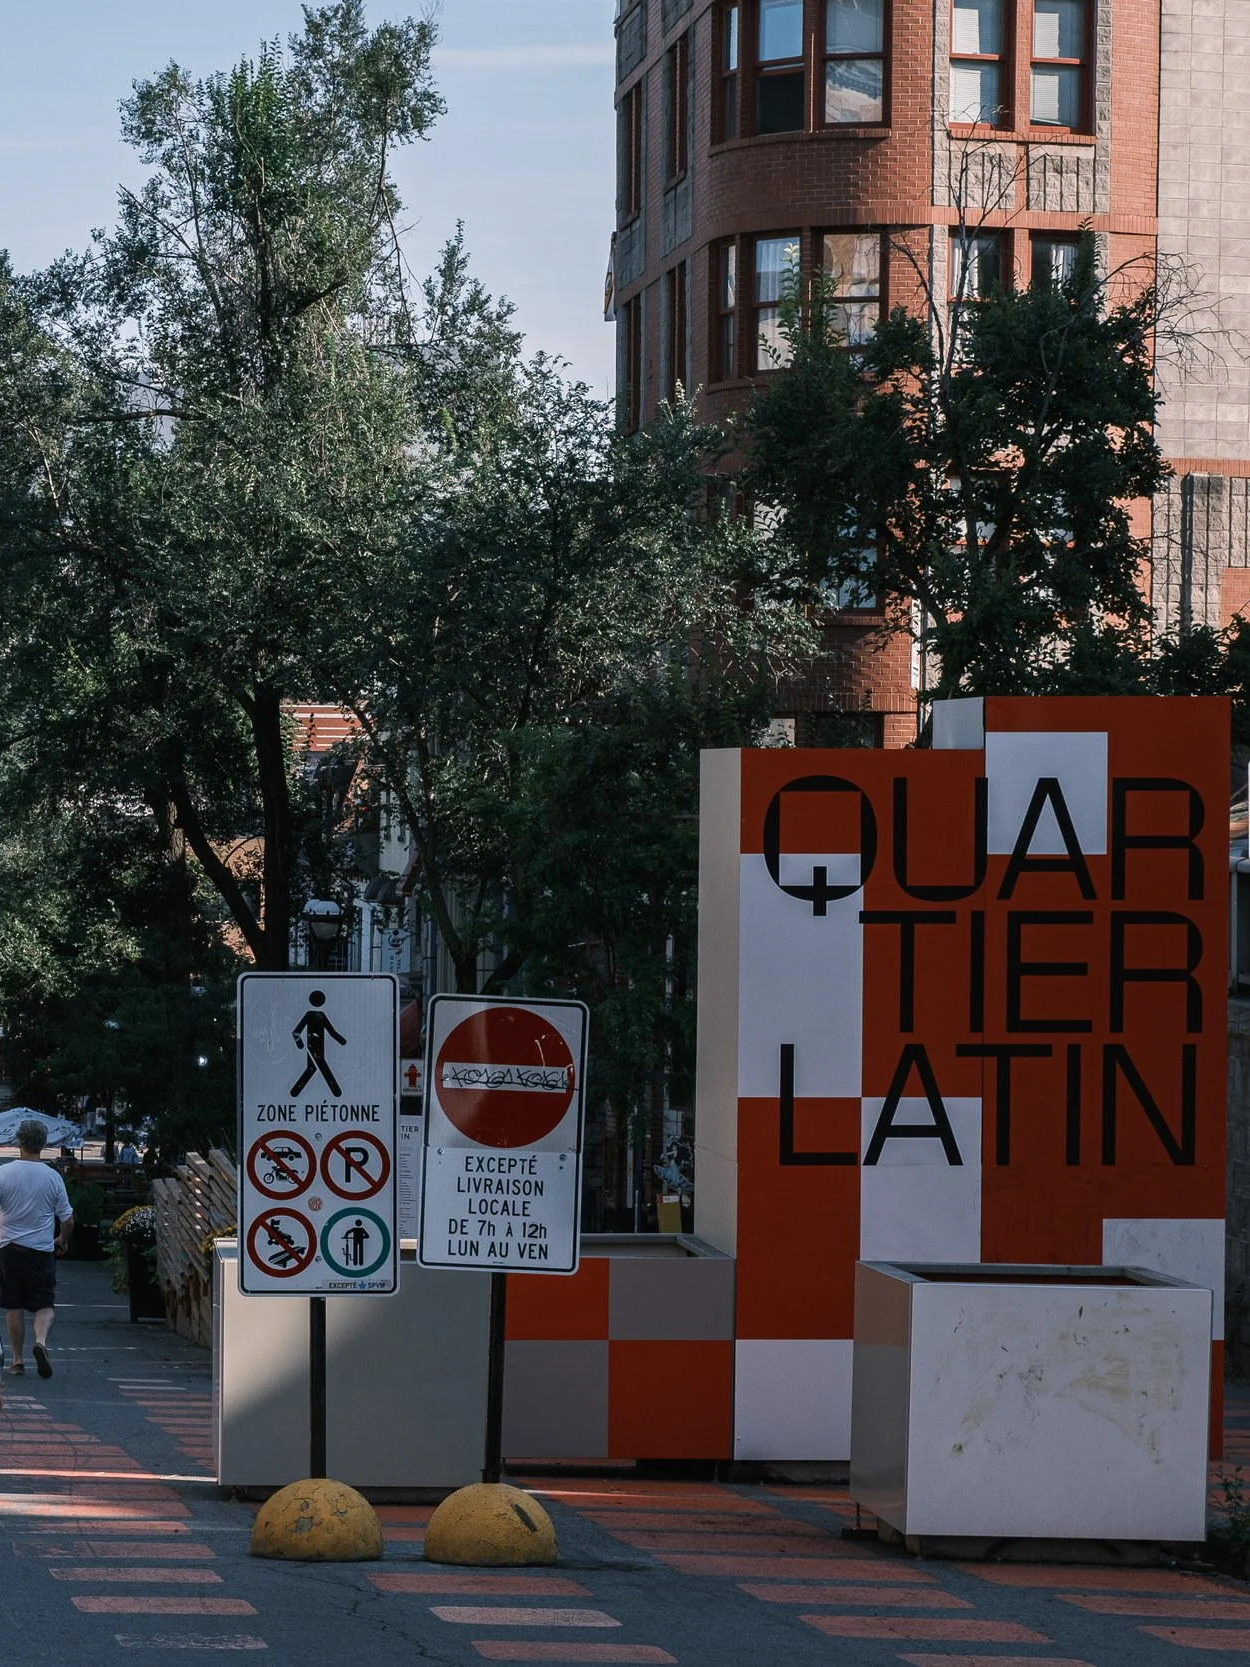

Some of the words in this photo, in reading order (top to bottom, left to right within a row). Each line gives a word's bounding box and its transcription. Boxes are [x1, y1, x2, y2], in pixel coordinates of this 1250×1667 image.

[762, 774, 1205, 917] QUAR
[858, 910, 1203, 1034] TIER
[256, 1105, 297, 1122] ZONE
[305, 1100, 380, 1122] PIÉTONNE
[779, 1043, 1197, 1166] LATIN
[400, 1125, 419, 1133] TIER
[464, 1154, 538, 1175] EXCEPTÉ
[456, 1176, 544, 1197] LIVRAISON
[468, 1199, 531, 1217] LOCALE
[448, 1219, 471, 1236] DE
[477, 1220, 496, 1237] 7h
[505, 1221, 515, 1238] À
[522, 1222, 548, 1239] 12h
[448, 1239, 479, 1257] LUN
[487, 1240, 509, 1258] AU
[517, 1242, 548, 1261] VEN
